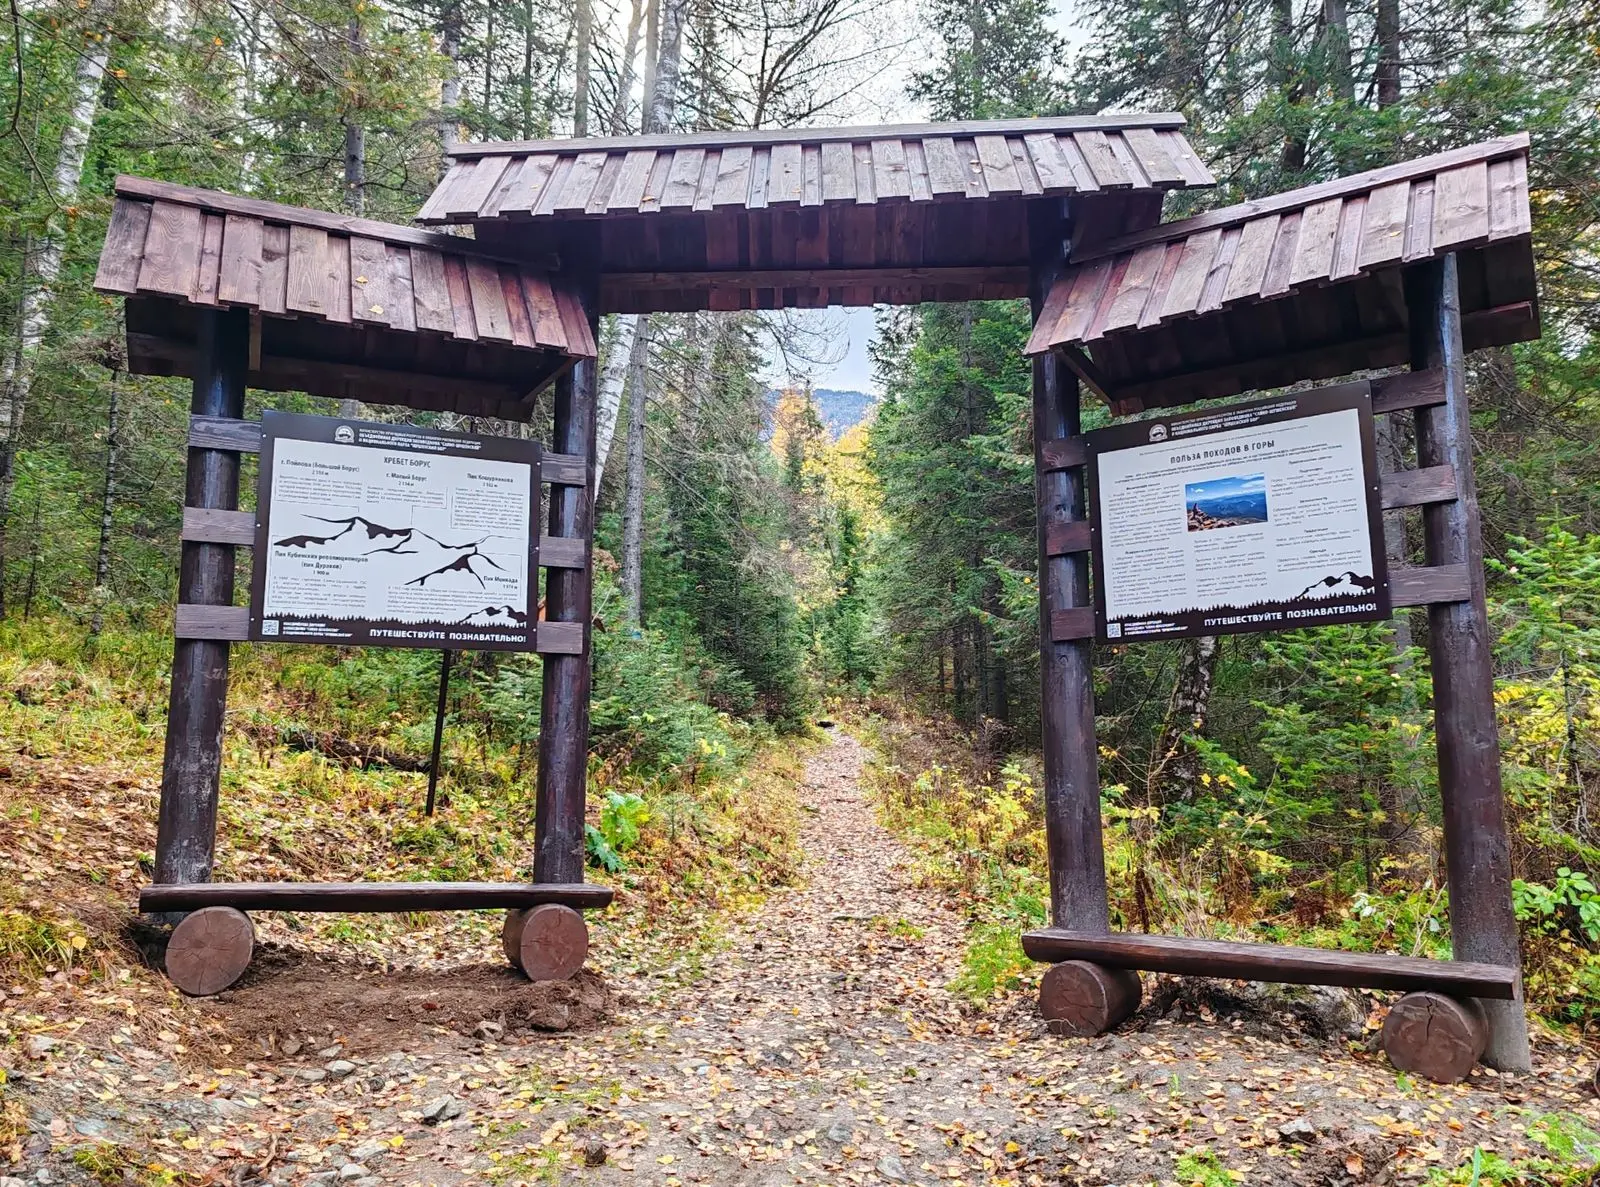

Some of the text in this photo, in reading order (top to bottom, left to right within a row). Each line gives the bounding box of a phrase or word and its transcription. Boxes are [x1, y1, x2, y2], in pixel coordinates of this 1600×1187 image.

[1170, 453, 1201, 464] ПОЛЬЗА
[1204, 445, 1241, 459] ПОХОДОВ
[1244, 443, 1249, 451] В
[1252, 440, 1275, 450] ГОРЫ
[383, 456, 431, 469] ХРЕБЕТ БОРУС
[1204, 602, 1377, 626] ПУТЕШЕСТВУЙТЕ ПОЗНАВАТЕЛЬНО!
[369, 628, 527, 643] ПУТЕШЕСТВУЙТЕ ПОЗНАВАТЕЛЬНО!
